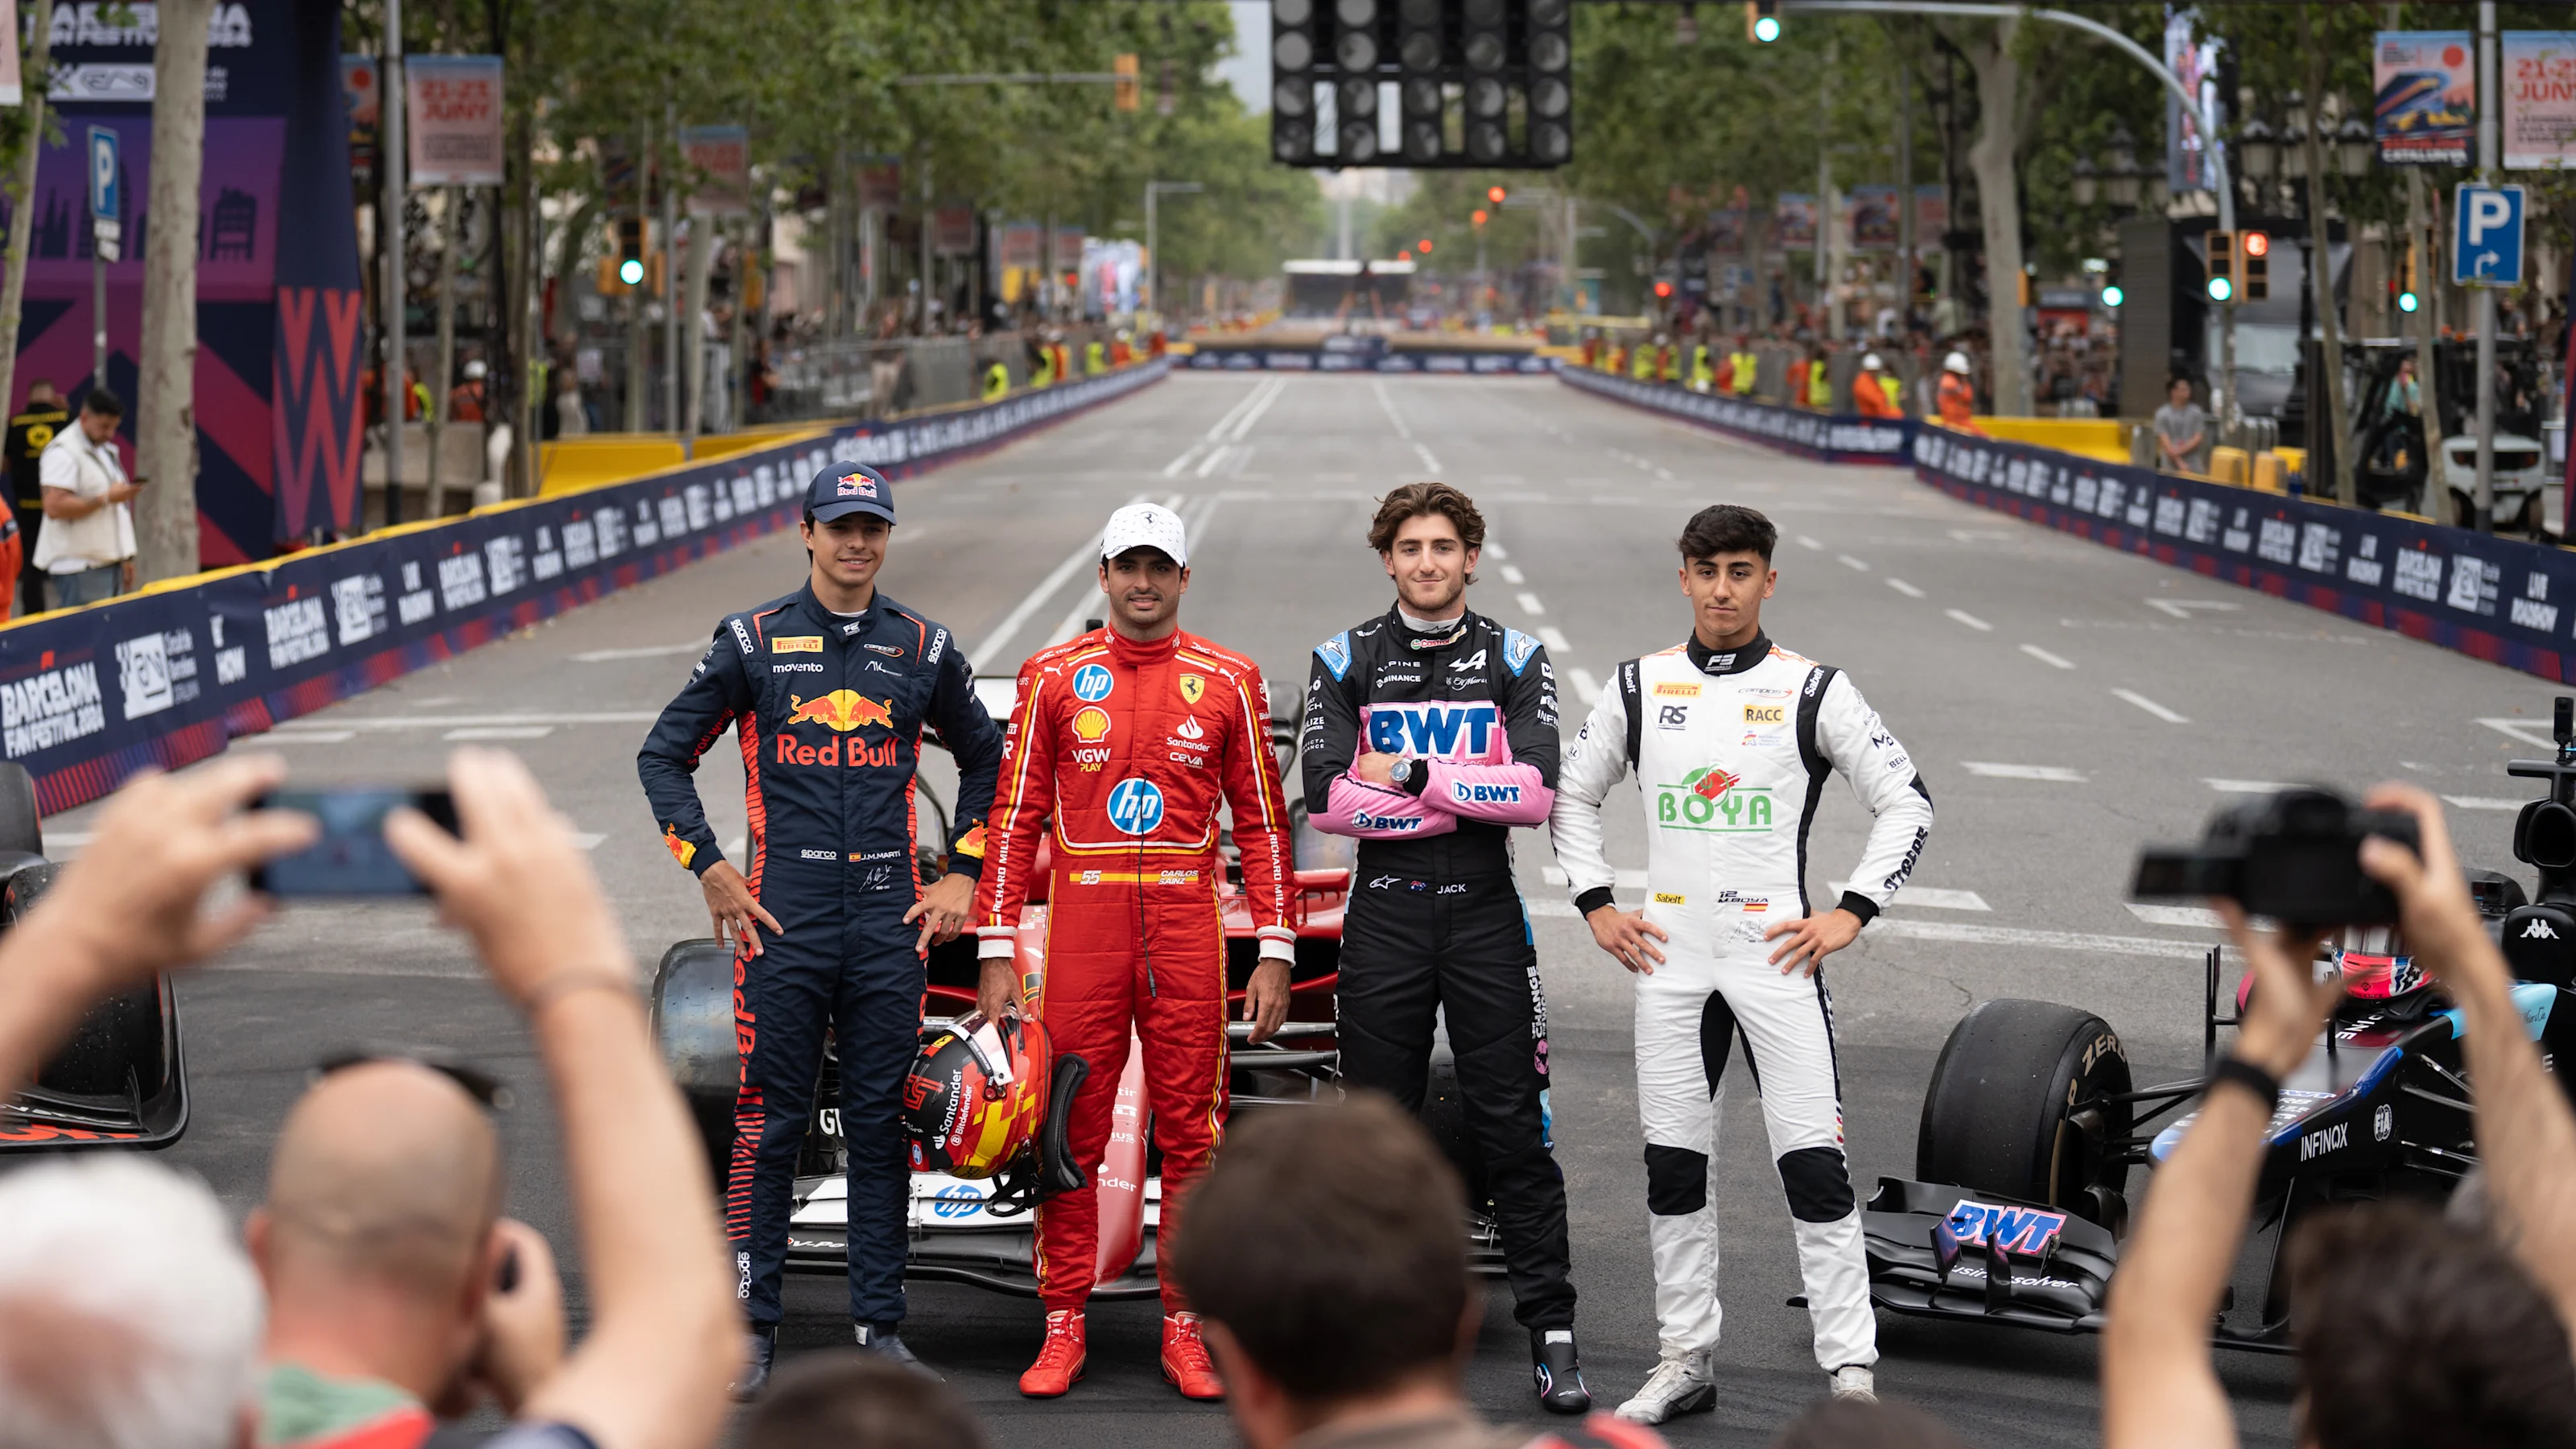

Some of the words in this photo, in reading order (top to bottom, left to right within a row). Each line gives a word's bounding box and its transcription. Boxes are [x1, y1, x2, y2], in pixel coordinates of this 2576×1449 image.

[96, 139, 114, 212] P
[2468, 193, 2512, 246] P
[838, 486, 857, 496] Red
[859, 487, 877, 498] Bull
[729, 618, 754, 655] sparco
[776, 639, 819, 650] PIRELLI
[927, 628, 947, 665] sparco
[773, 663, 824, 673] movento
[1707, 653, 1737, 667] F3
[0, 661, 102, 729] BARCELONA
[1079, 666, 1108, 700] hp
[1383, 675, 1422, 683] BINANCE
[1624, 663, 1637, 695] Sabelt
[1655, 685, 1699, 696] PIRELLI
[1804, 667, 1826, 698] Sabelt
[1659, 705, 1688, 724] RS
[1746, 708, 1782, 721] RACC
[1166, 737, 1211, 753] Santander
[1369, 708, 1496, 755] BWT
[777, 733, 840, 766] Red
[847, 737, 900, 767] Bull
[1071, 749, 1111, 763] VGW
[1889, 754, 1907, 770] BELL
[1080, 762, 1103, 773] PLAY
[1115, 781, 1158, 832] hp
[1474, 785, 1520, 802] BWT
[1658, 791, 1772, 825] BOYA
[1373, 817, 1422, 830] BWT
[800, 848, 837, 861] sparco
[998, 831, 1011, 864] MILLE
[1269, 834, 1282, 881] RICHARD
[992, 866, 1007, 913] RICHARD
[1080, 870, 1101, 885] 55
[1158, 877, 1186, 886] SAINZ
[1436, 883, 1467, 894] JACK
[1656, 894, 1682, 904] Sabelt
[1526, 965, 1542, 1038] CHANGE
[2082, 1034, 2128, 1077] ZERO
[939, 1068, 962, 1135] Santander
[955, 1084, 973, 1135] Bitdefender
[2300, 1121, 2348, 1162] INFINOX
[1951, 1203, 2063, 1251] BWT
[737, 1250, 752, 1299] sparco
